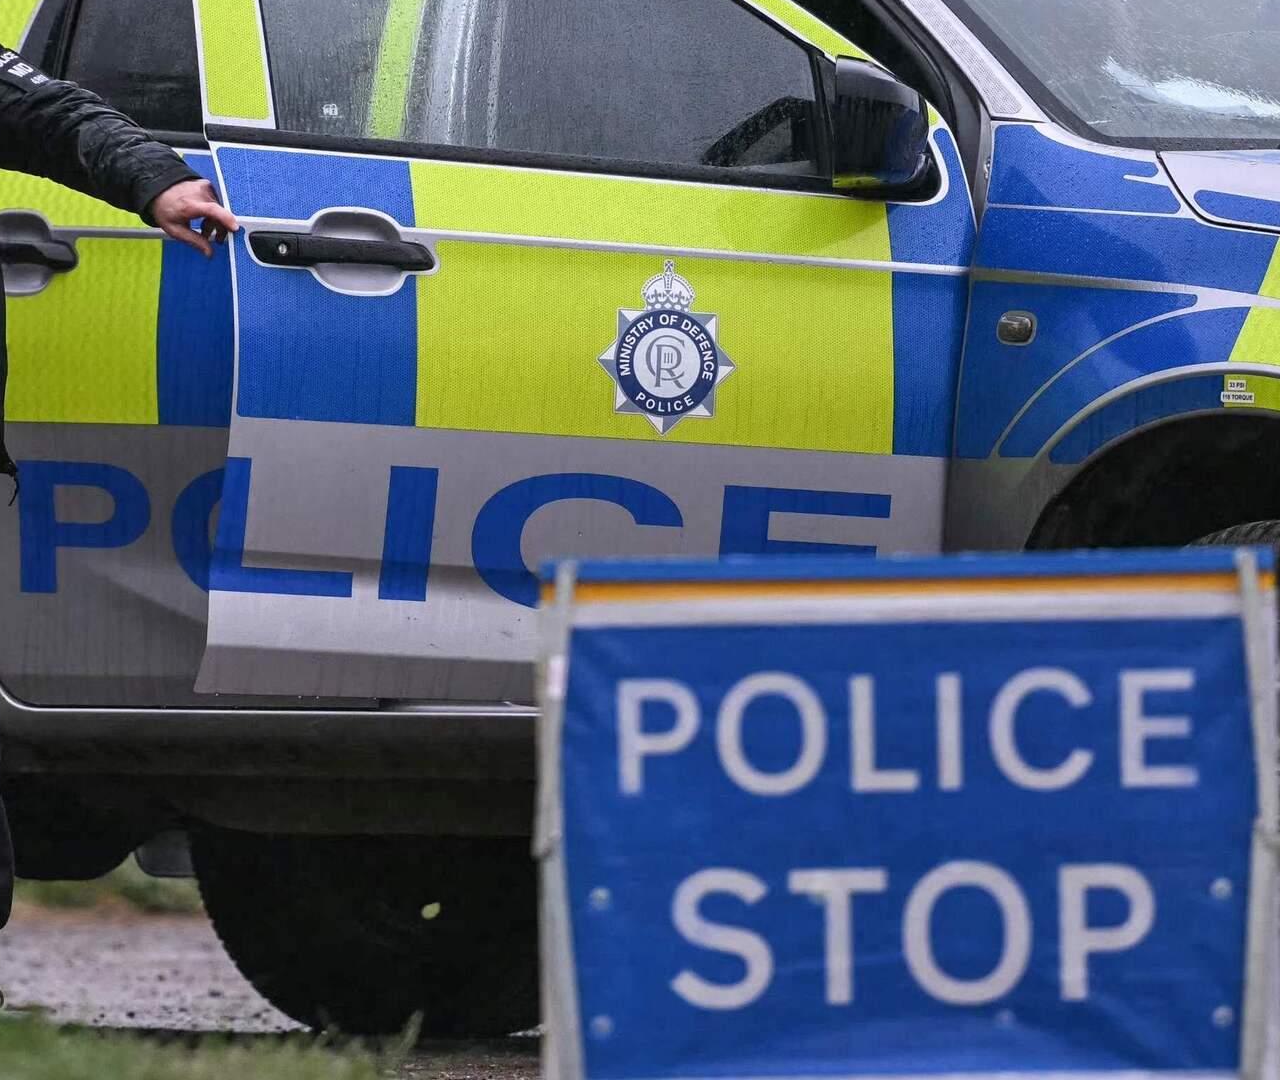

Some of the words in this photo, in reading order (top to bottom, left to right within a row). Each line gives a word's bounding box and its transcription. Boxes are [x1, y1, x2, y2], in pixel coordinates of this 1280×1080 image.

[7, 62, 34, 77] MD
[619, 316, 655, 377] MINISTRY
[659, 313, 679, 326] OF
[681, 318, 715, 381] DEFENCE
[635, 392, 695, 412] POLICE
[616, 668, 1199, 797] POLICE
[669, 861, 1158, 1011] STOP
